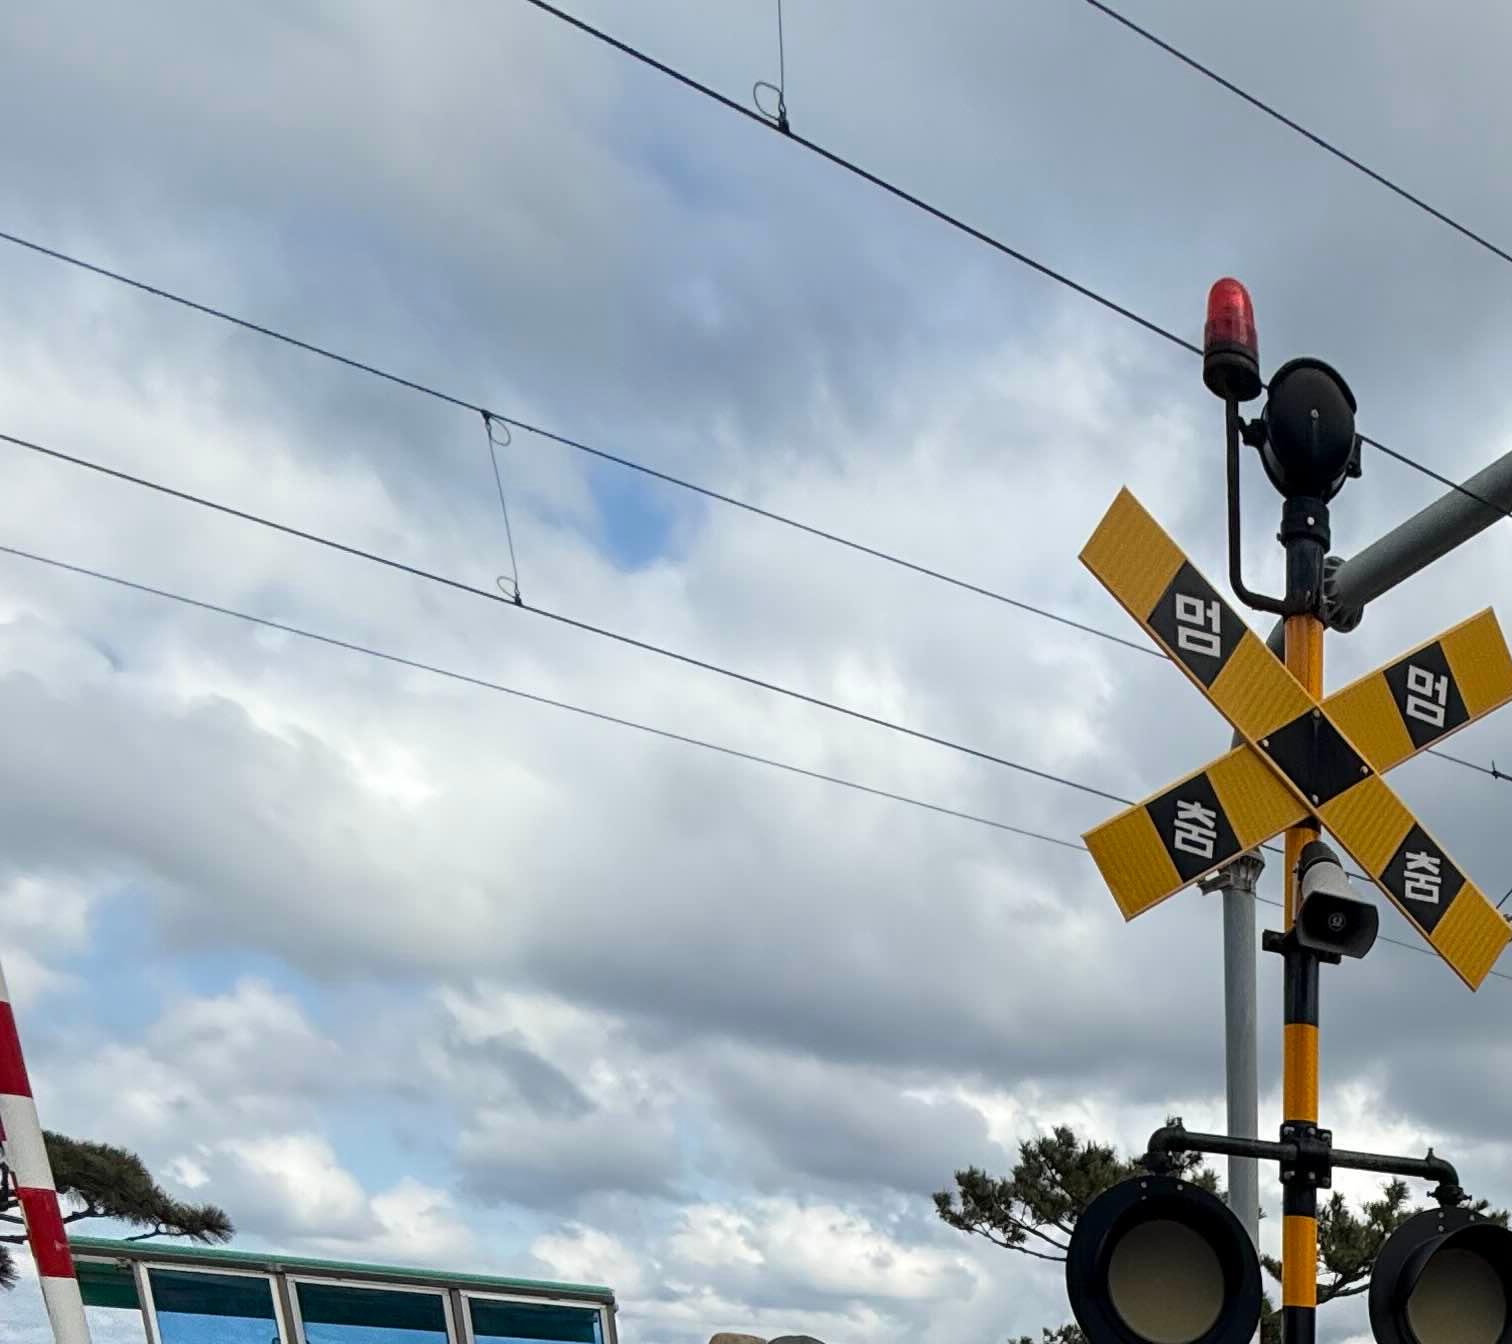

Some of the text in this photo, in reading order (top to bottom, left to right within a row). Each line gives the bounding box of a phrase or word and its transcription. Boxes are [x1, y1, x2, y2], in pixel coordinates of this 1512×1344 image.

[1176, 593, 1221, 658] 멈
[1406, 664, 1448, 728] 멈
[1173, 800, 1217, 859] 춤
[1403, 851, 1442, 904] 춤
